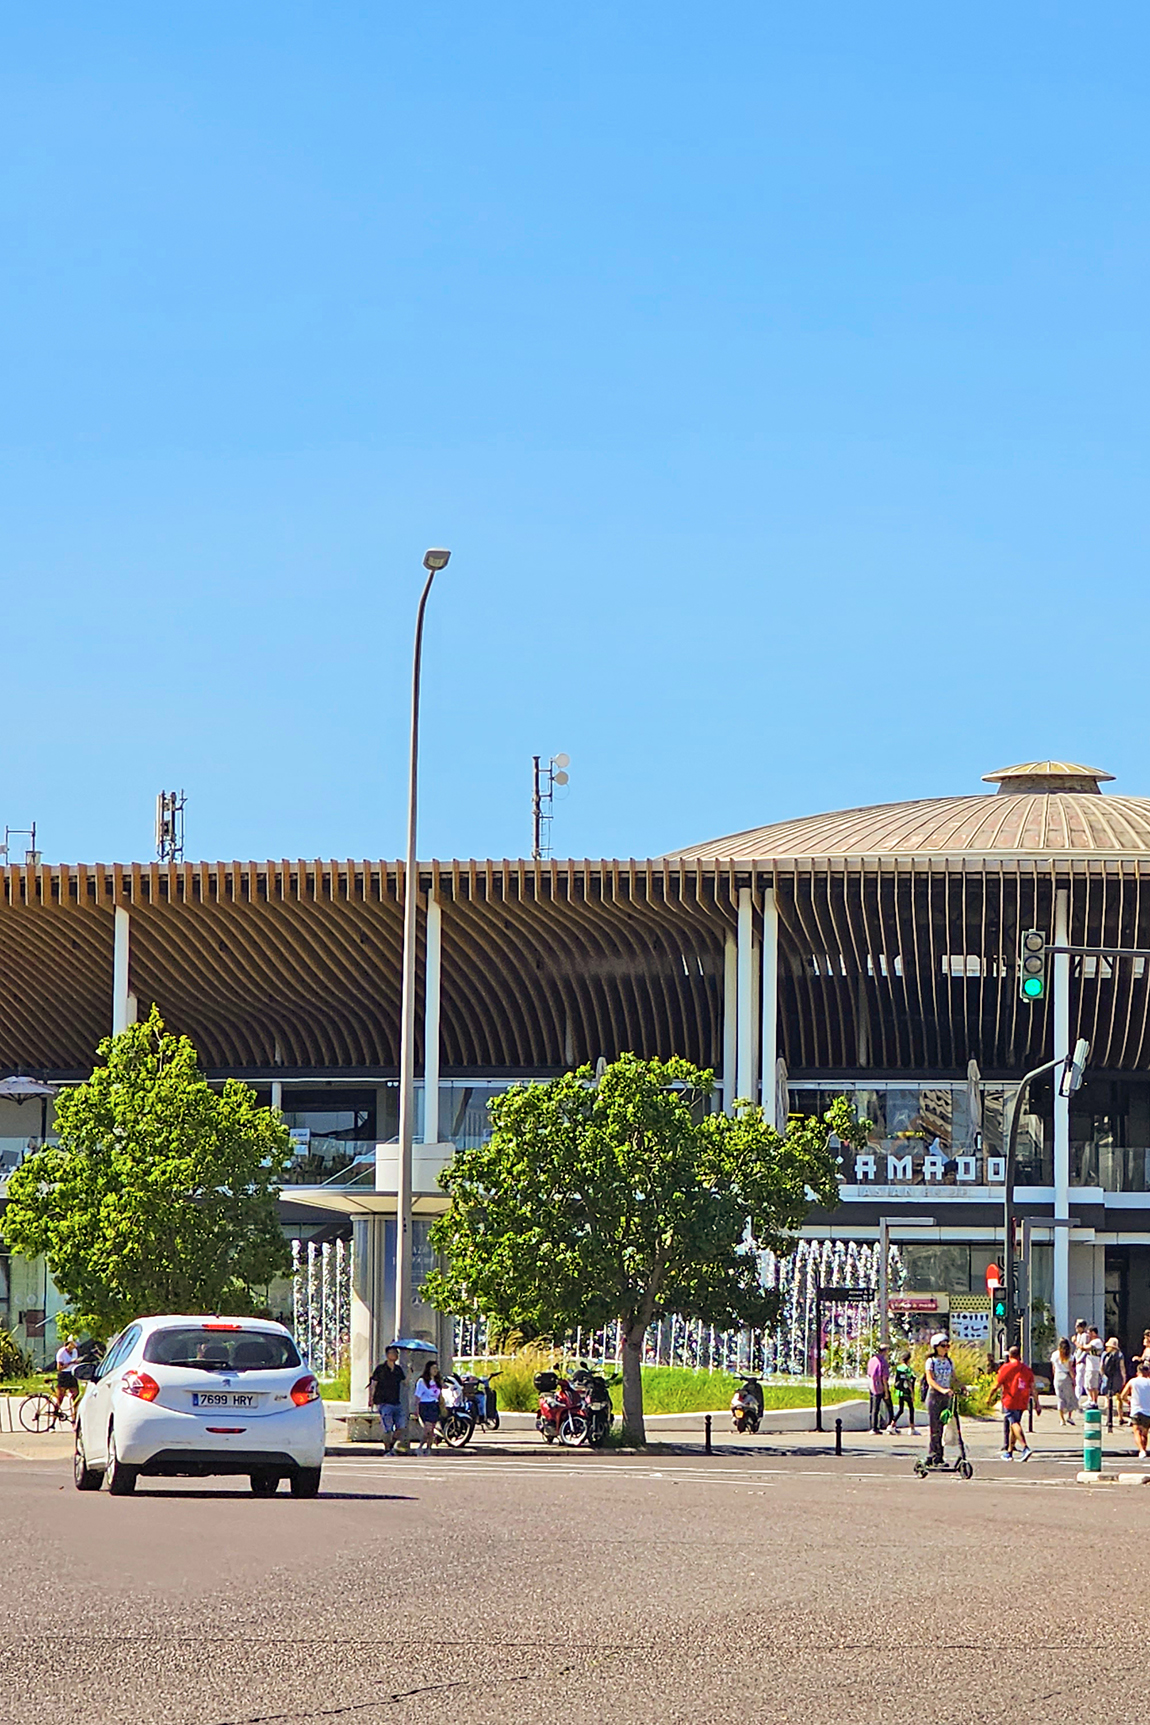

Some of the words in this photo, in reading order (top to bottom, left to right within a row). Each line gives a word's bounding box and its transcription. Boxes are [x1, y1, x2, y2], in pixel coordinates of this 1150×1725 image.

[862, 1186, 914, 1197] ASIAN
[200, 1394, 228, 1405] 7699
[233, 1395, 253, 1406] HRY
